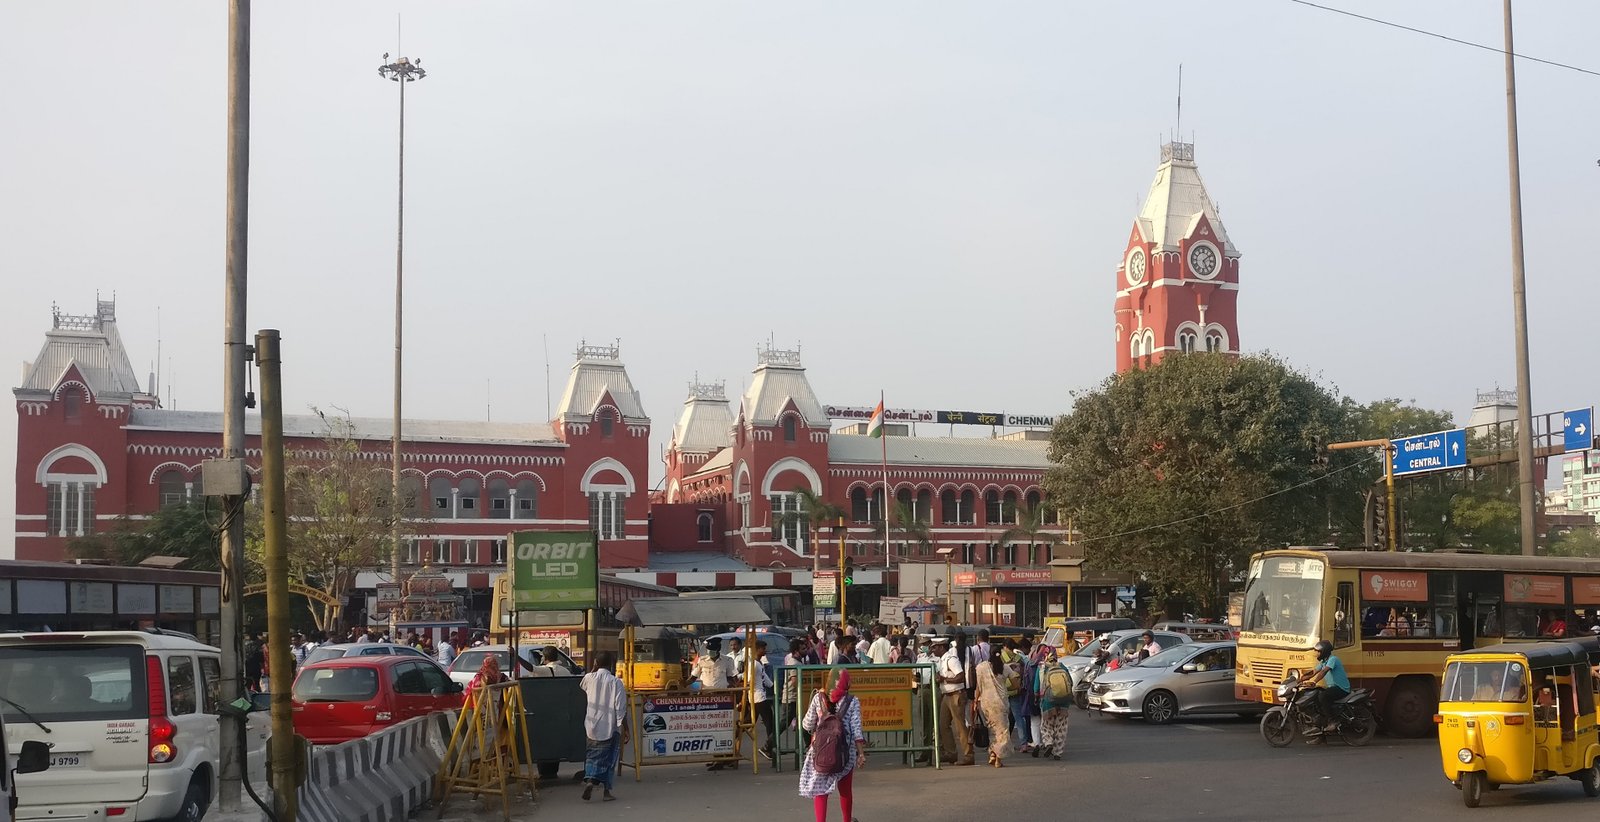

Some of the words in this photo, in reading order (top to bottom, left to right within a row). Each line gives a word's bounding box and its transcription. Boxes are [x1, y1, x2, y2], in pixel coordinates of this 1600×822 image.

[1008, 416, 1054, 426] CHENNAI
[1409, 455, 1441, 468] CENTRAL
[516, 542, 592, 560] ORBIT
[532, 562, 579, 576] LED
[1384, 579, 1418, 588] SWIGGY
[655, 697, 683, 705] CHENNAI
[685, 696, 710, 704] TRAFFIC
[710, 695, 732, 703] POLICE
[673, 739, 713, 753] ORBIT
[715, 739, 733, 747] LED
[58, 756, 79, 766] 9799
